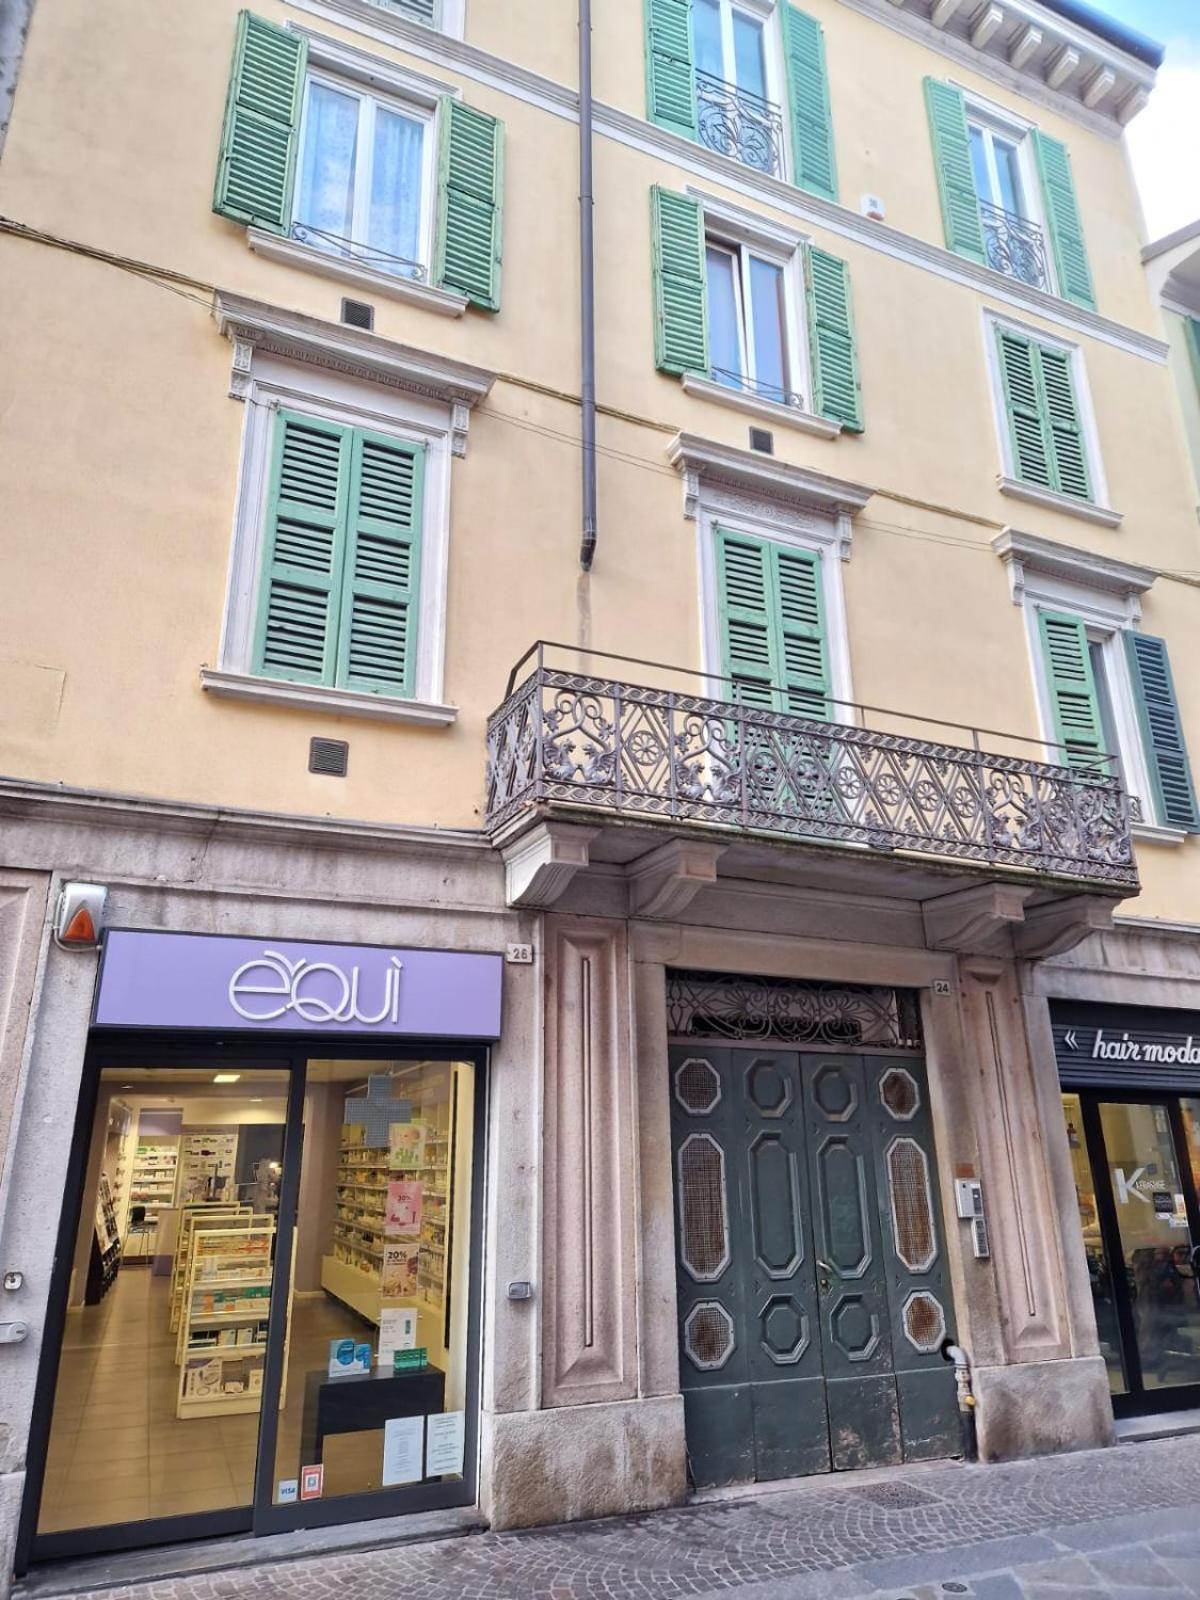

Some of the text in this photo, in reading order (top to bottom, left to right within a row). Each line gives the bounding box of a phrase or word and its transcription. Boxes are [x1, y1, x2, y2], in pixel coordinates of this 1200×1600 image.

[513, 948, 528, 960] 26
[936, 982, 949, 993] 24
[1091, 1029, 1141, 1061] hair
[387, 1250, 408, 1260] 20%
[280, 1487, 296, 1496] VISA
